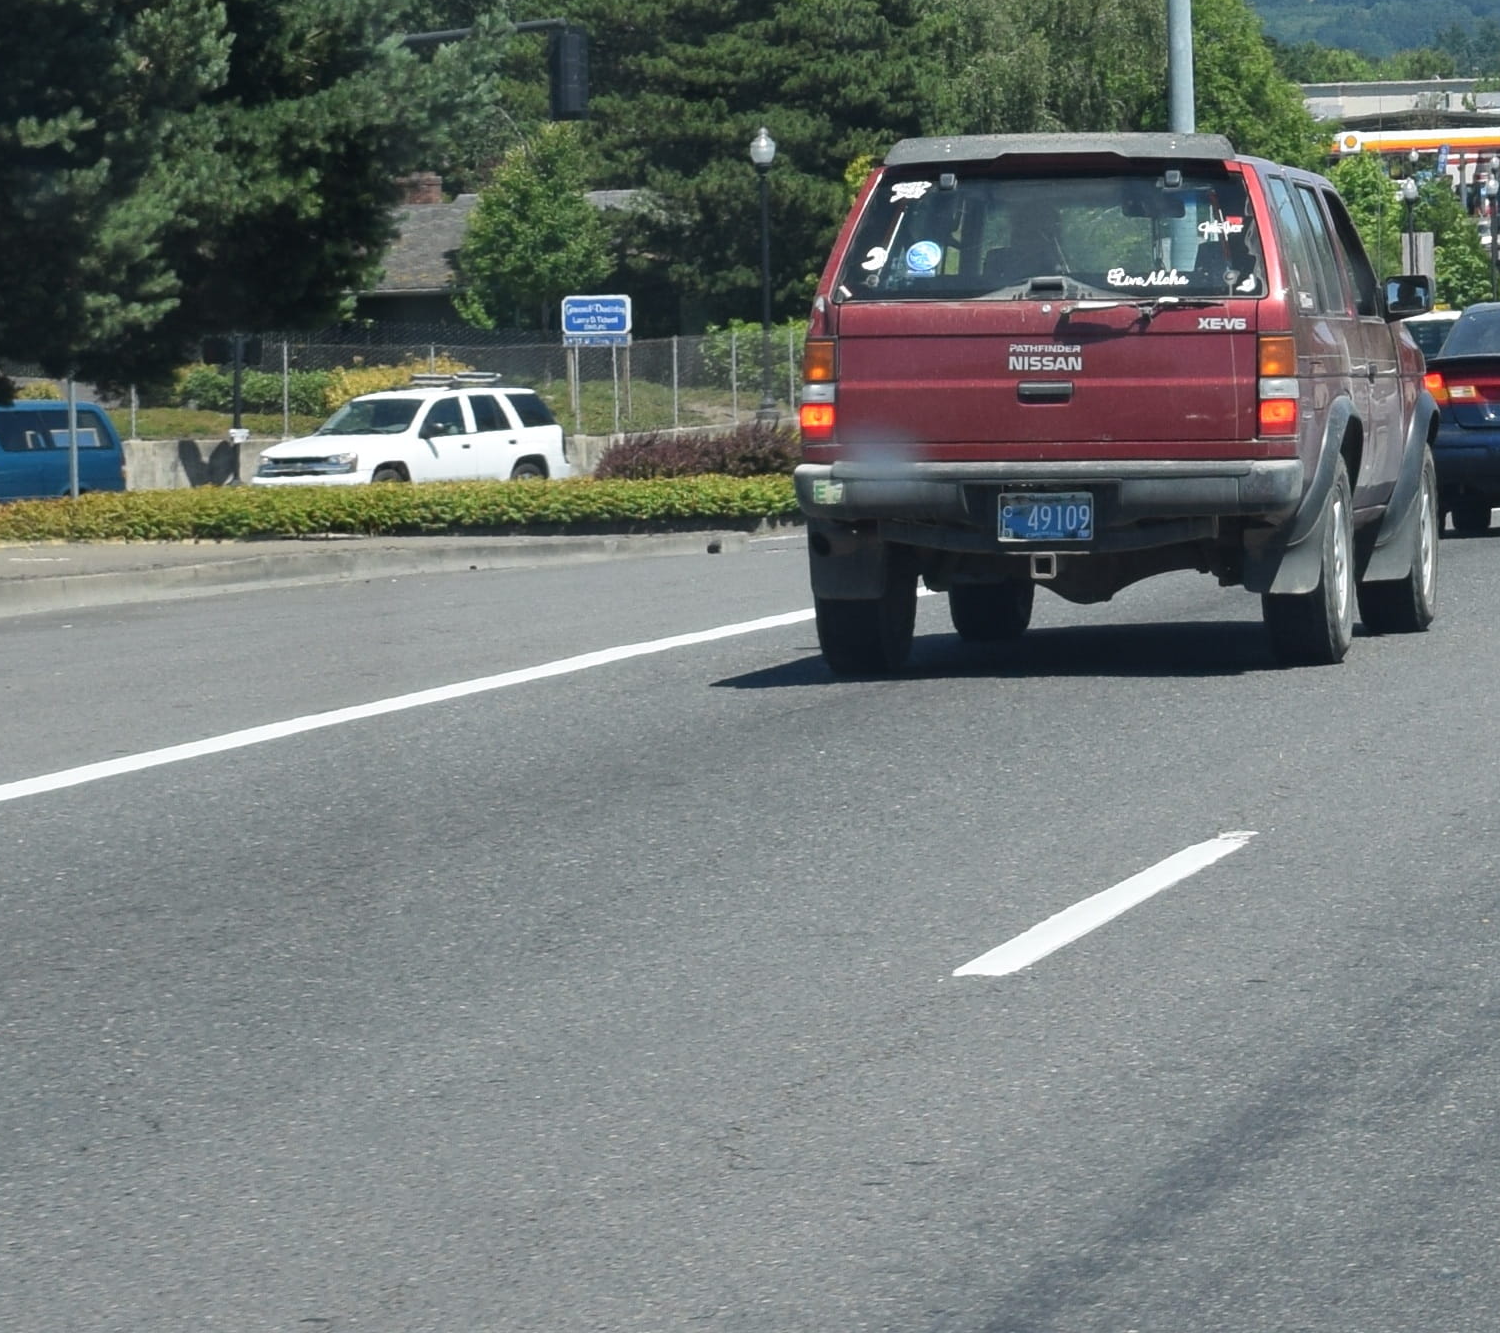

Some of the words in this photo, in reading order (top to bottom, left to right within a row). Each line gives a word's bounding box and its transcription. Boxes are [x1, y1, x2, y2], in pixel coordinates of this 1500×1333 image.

[1197, 317, 1247, 330] XE-V6
[1008, 343, 1082, 353] PATHFINDER
[1008, 355, 1083, 371] NISSAN
[1027, 505, 1090, 531] 49109
